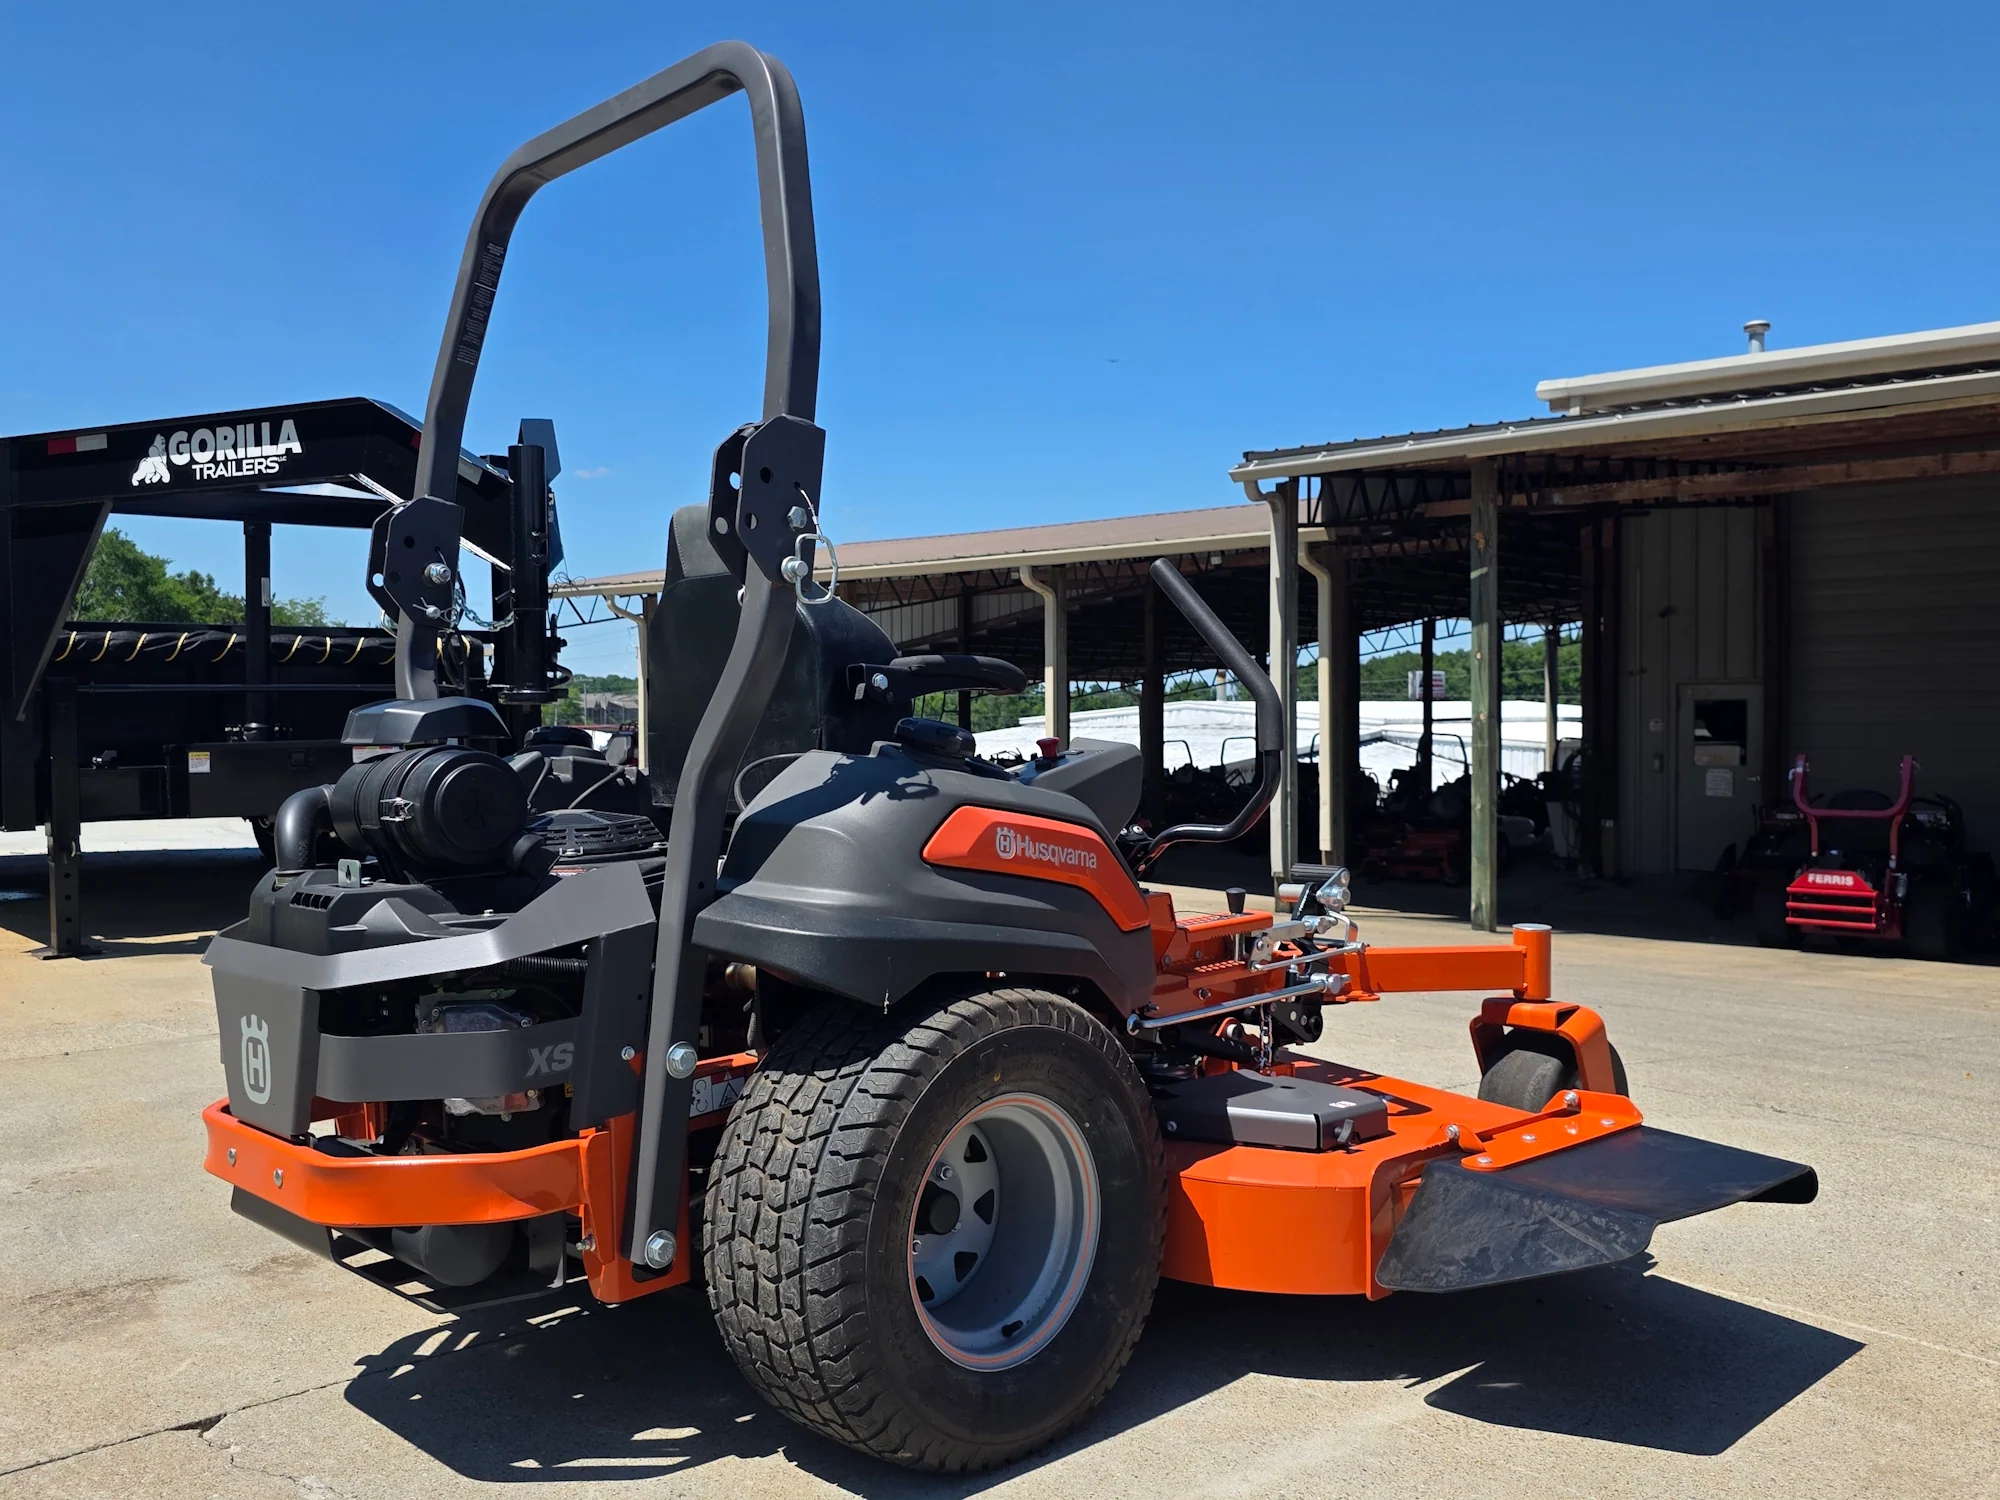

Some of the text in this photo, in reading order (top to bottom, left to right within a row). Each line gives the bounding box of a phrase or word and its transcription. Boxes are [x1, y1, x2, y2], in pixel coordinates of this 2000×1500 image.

[168, 419, 302, 466] GORILLA
[191, 456, 280, 480] TRAILERS
[1016, 833, 1097, 869] Husqvarna
[1807, 873, 1854, 886] FERRIS
[526, 1042, 574, 1077] XS
